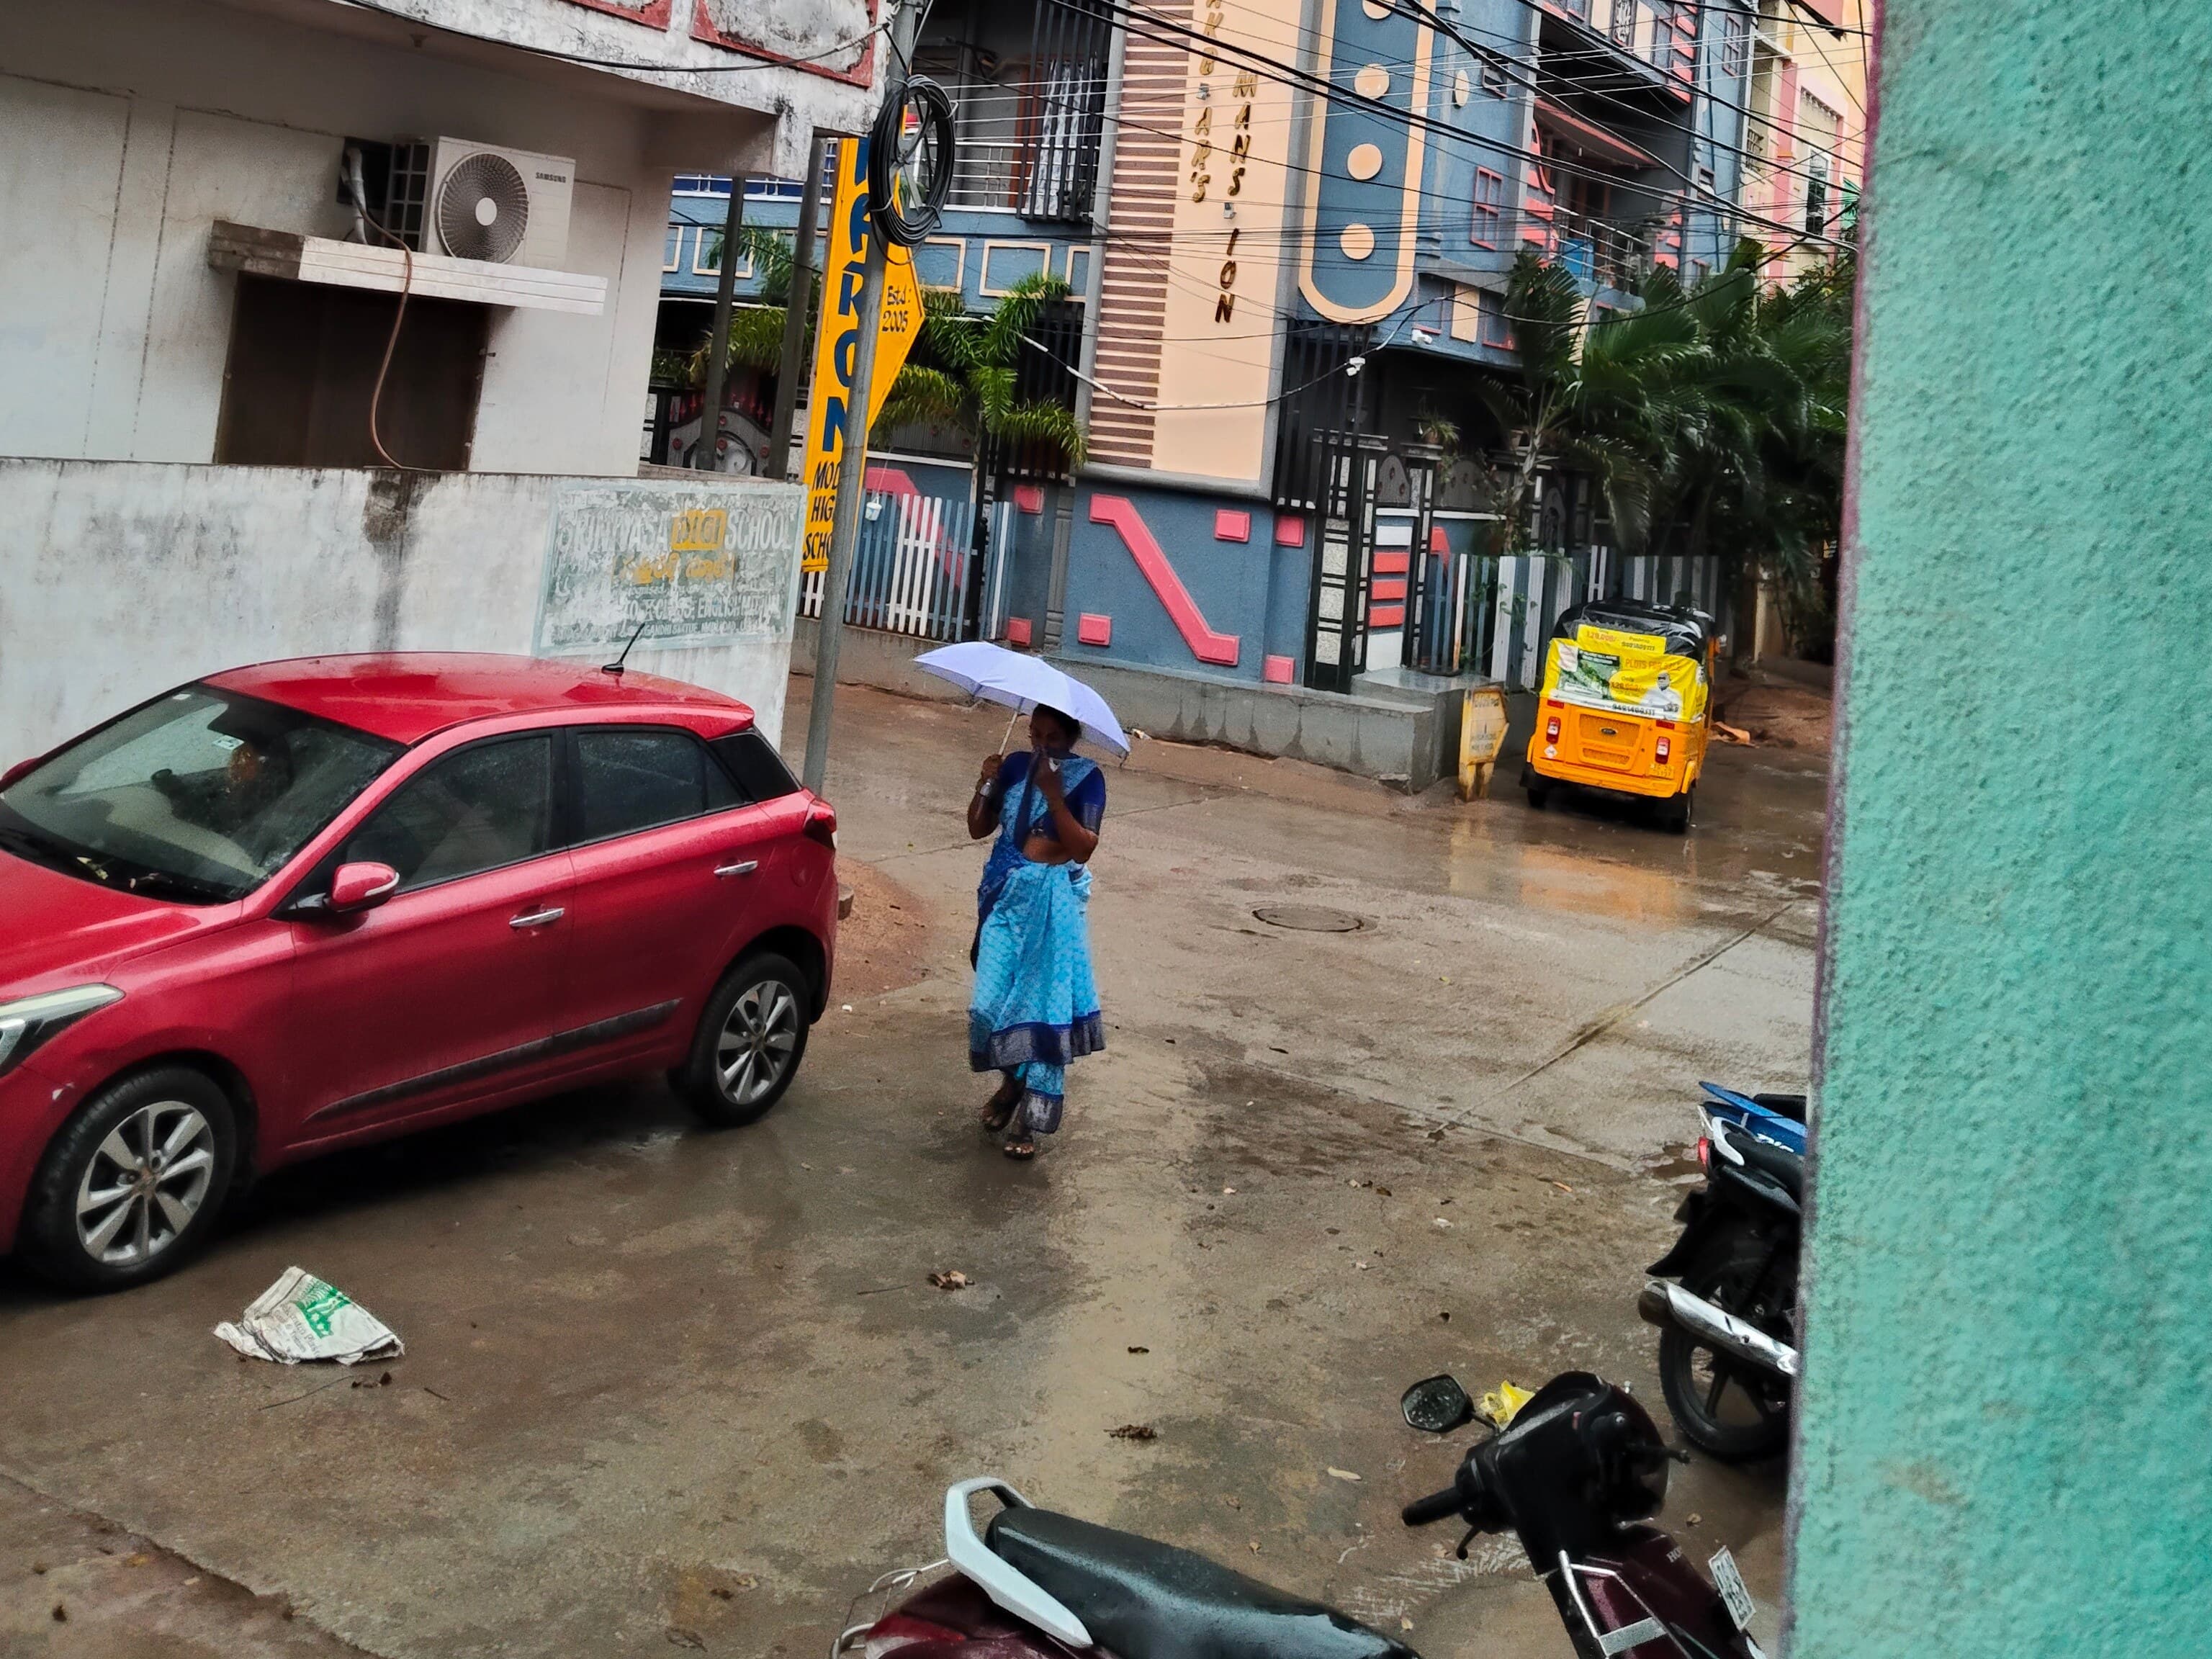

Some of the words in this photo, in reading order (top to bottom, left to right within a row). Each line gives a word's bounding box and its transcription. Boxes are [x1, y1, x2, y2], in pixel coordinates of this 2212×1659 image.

[536, 172, 566, 183] SAMSUNG
[1215, 70, 1258, 323] MANSION
[882, 310, 909, 332] 2005
[811, 495, 835, 523] HIG
[724, 508, 791, 551] SCHOOL
[1625, 658, 1647, 670] PLOTS
